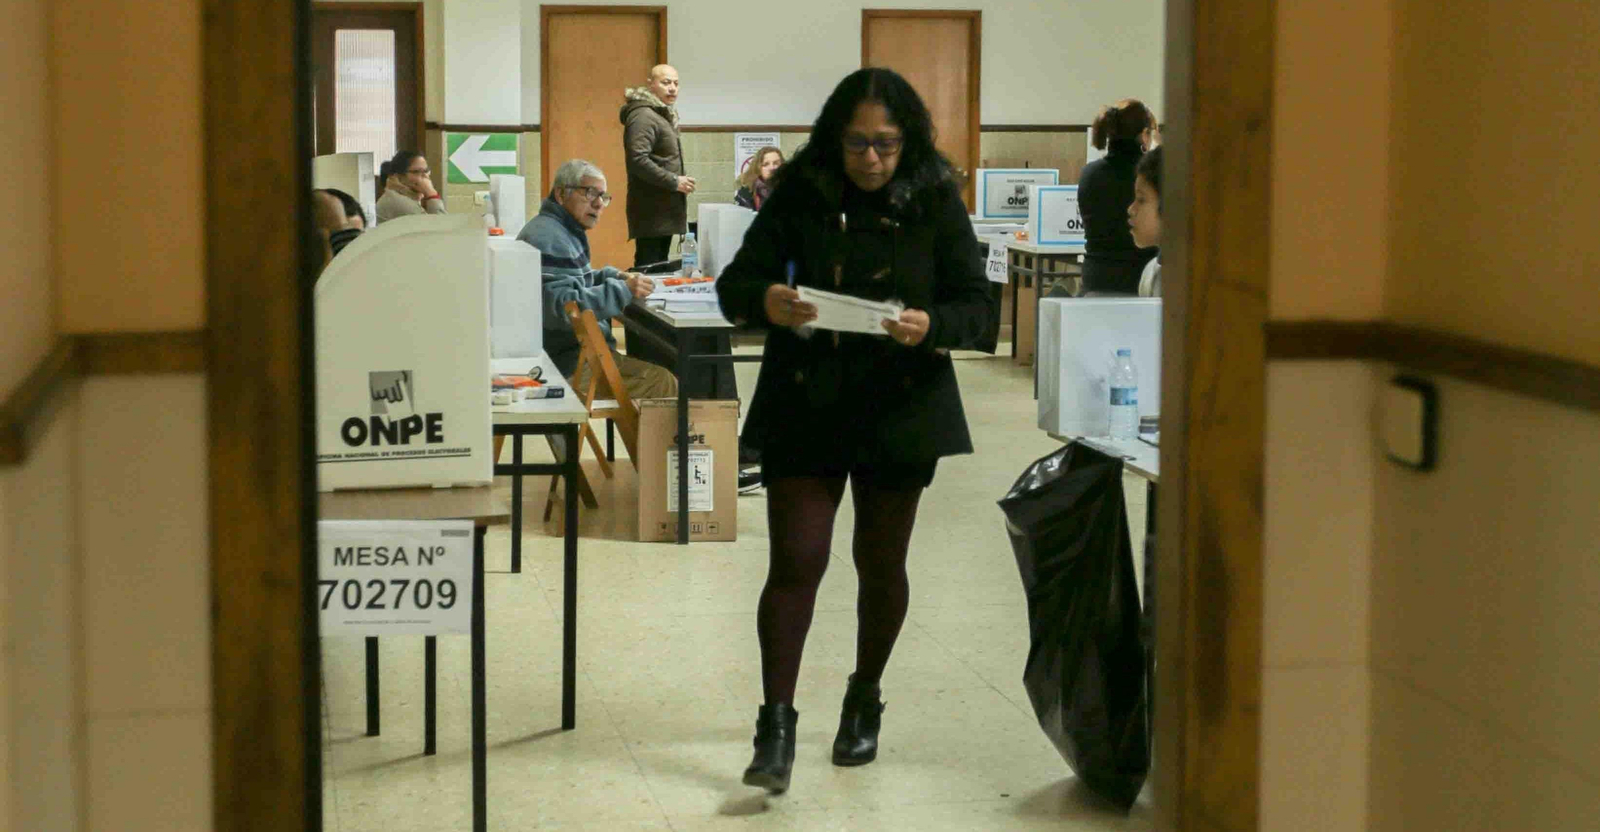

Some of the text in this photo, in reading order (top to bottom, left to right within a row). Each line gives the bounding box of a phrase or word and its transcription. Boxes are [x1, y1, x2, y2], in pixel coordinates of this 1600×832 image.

[1007, 197, 1029, 205] ONP
[1066, 219, 1084, 229] ON
[340, 412, 444, 447] ONPE
[333, 546, 409, 566] MESA
[317, 578, 457, 610] 702709
